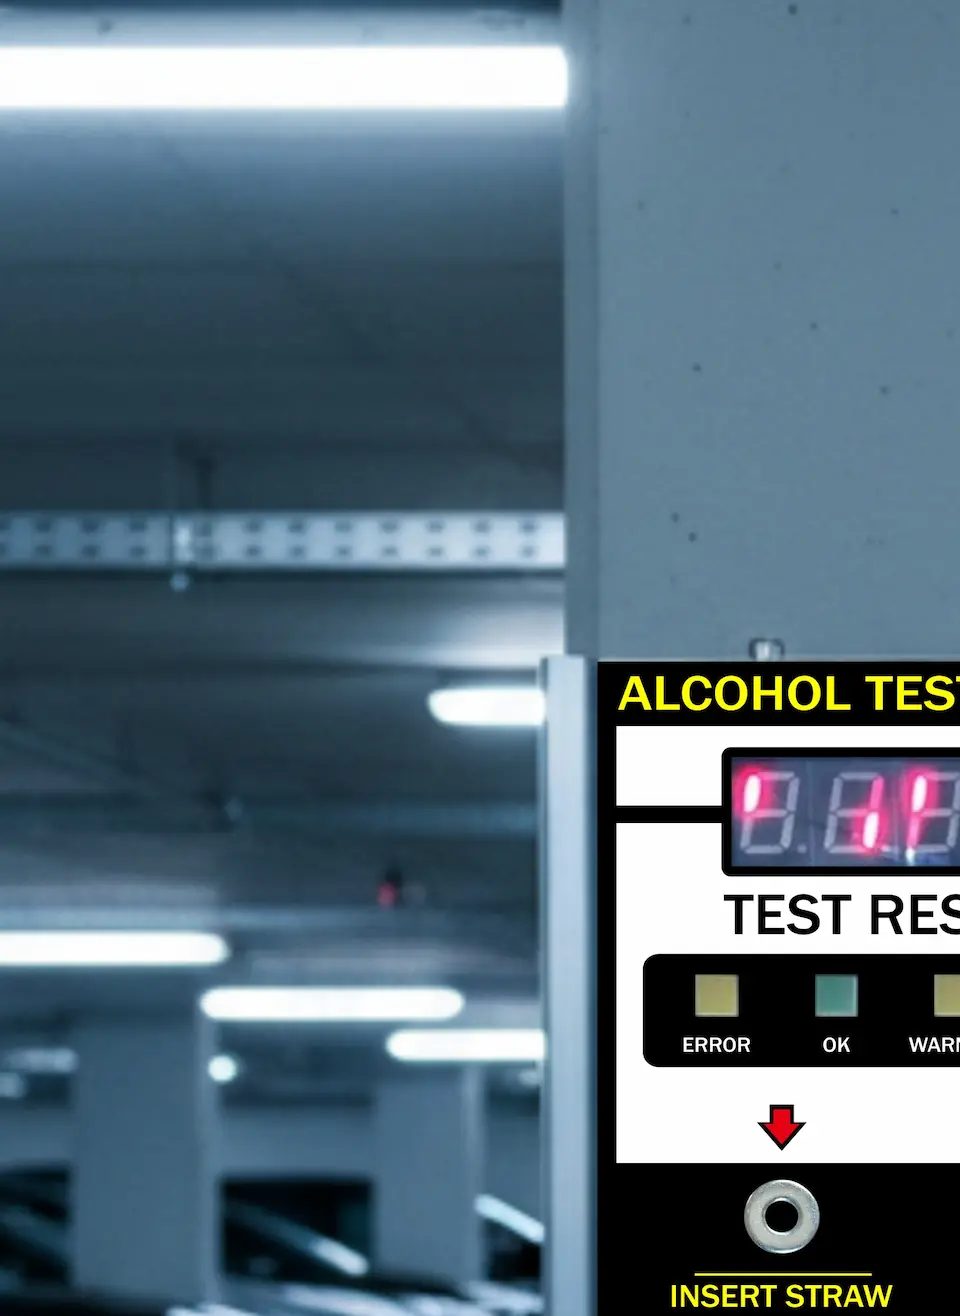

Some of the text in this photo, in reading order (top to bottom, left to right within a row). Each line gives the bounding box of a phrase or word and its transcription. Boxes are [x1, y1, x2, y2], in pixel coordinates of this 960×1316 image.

[618, 675, 851, 711] ALCOHOL
[723, 893, 852, 936] TEST
[682, 1036, 751, 1053] ERROR
[822, 1036, 851, 1053] OK
[671, 1283, 894, 1309] INSERT STRAW
